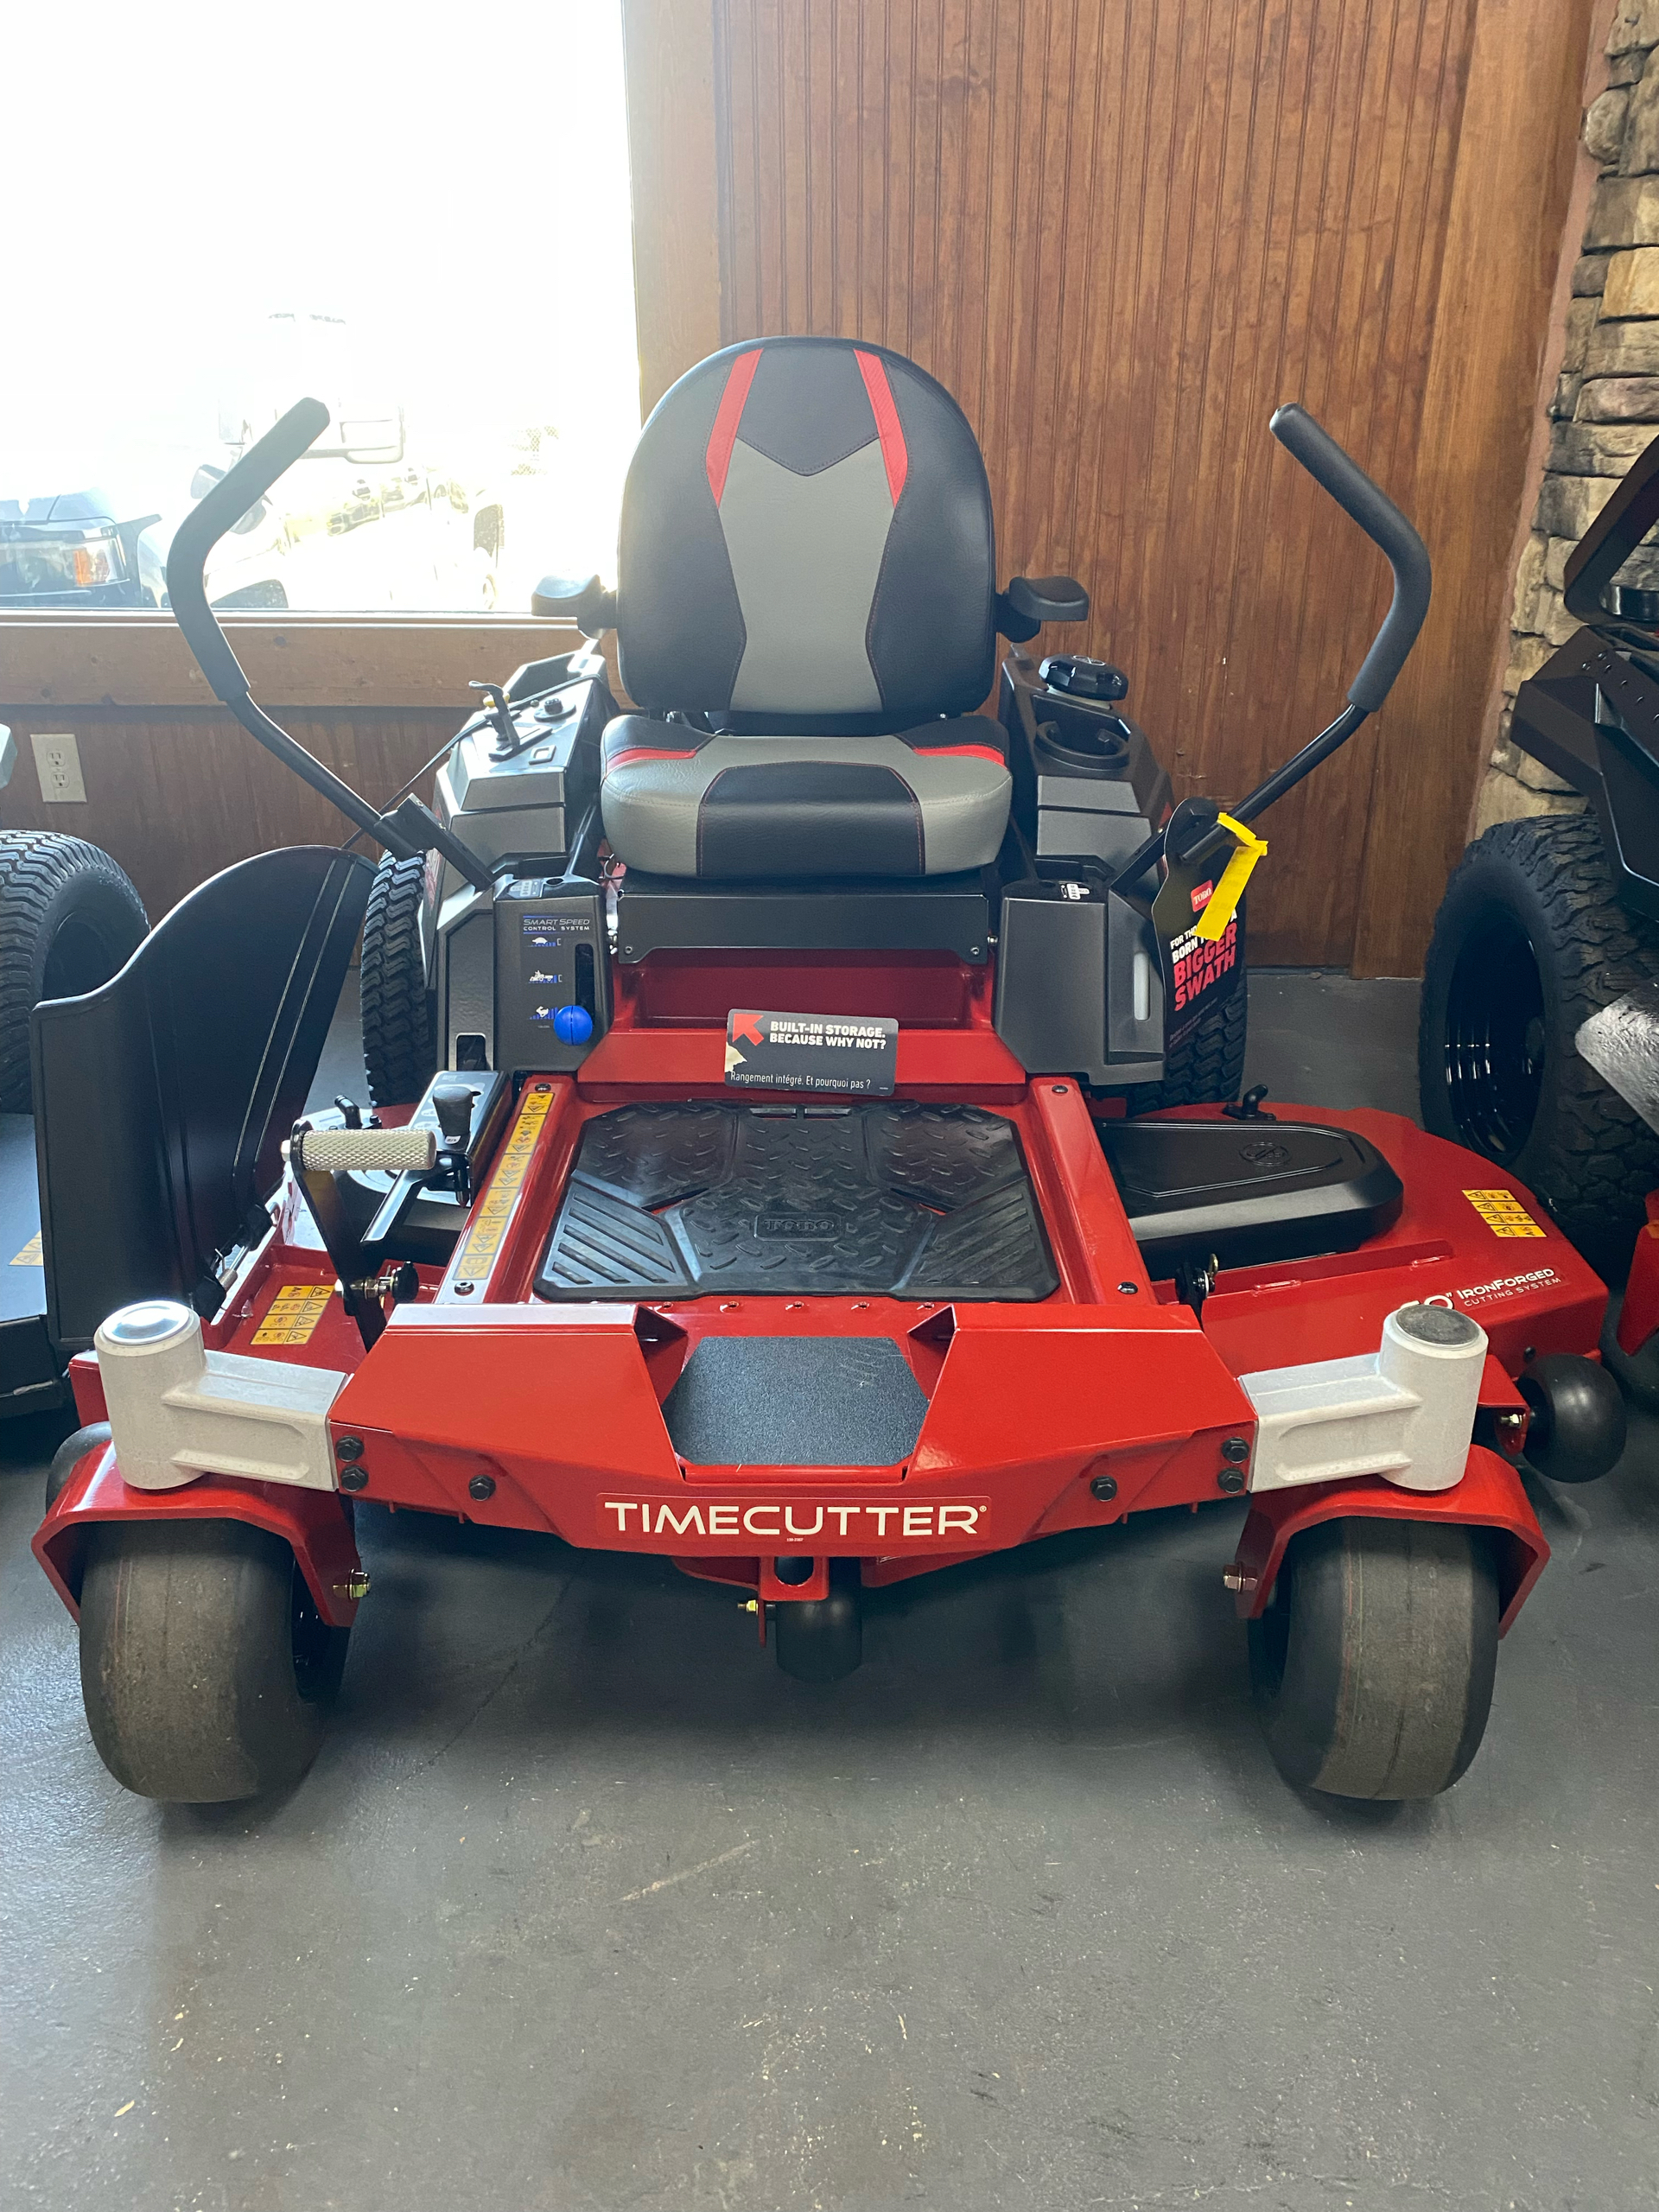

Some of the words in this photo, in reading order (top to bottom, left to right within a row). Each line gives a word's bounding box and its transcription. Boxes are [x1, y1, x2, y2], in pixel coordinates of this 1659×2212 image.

[1193, 887, 1211, 905] TORO
[1170, 936, 1184, 950] FOR
[1184, 925, 1198, 939] THO
[1172, 937, 1198, 963] BORN
[1173, 922, 1237, 988] BIGGER
[1174, 944, 1236, 1012] SWATH
[769, 1033, 823, 1046] BECAUSE
[825, 1037, 853, 1048] WHY
[855, 1039, 887, 1050] NOT?
[770, 1020, 823, 1034] BUILT-IN
[825, 1024, 886, 1038] STORAGE.
[730, 1071, 773, 1084] Rangement
[775, 1073, 804, 1087] intégré.
[805, 1075, 814, 1085] Et
[815, 1077, 849, 1089] pourquoi
[866, 1079, 871, 1090] ?
[764, 1218, 835, 1231] TORO
[1456, 1268, 1555, 1300] IRONFORGED
[1464, 1289, 1513, 1307] CUTTING
[1516, 1278, 1561, 1294] SYSTEM
